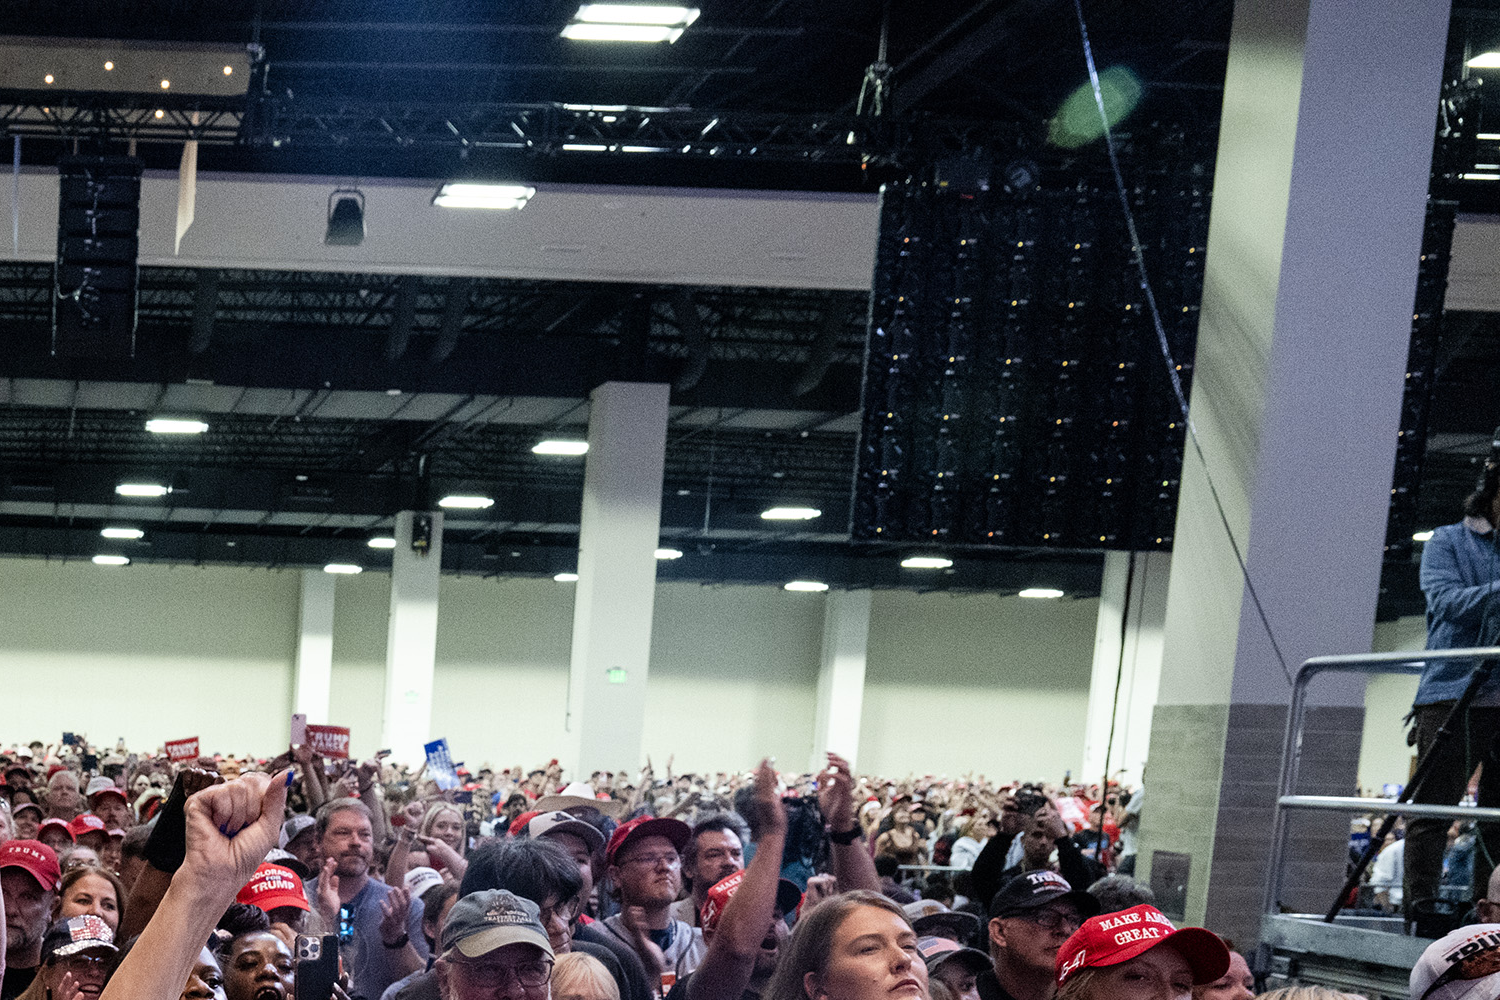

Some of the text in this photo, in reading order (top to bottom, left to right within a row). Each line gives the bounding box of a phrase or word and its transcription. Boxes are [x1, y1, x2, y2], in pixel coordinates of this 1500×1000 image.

[8, 847, 46, 861] TRUMP
[251, 879, 295, 893] TRUMP
[1099, 912, 1142, 931] MAKE
[1114, 926, 1160, 946] GREAT
